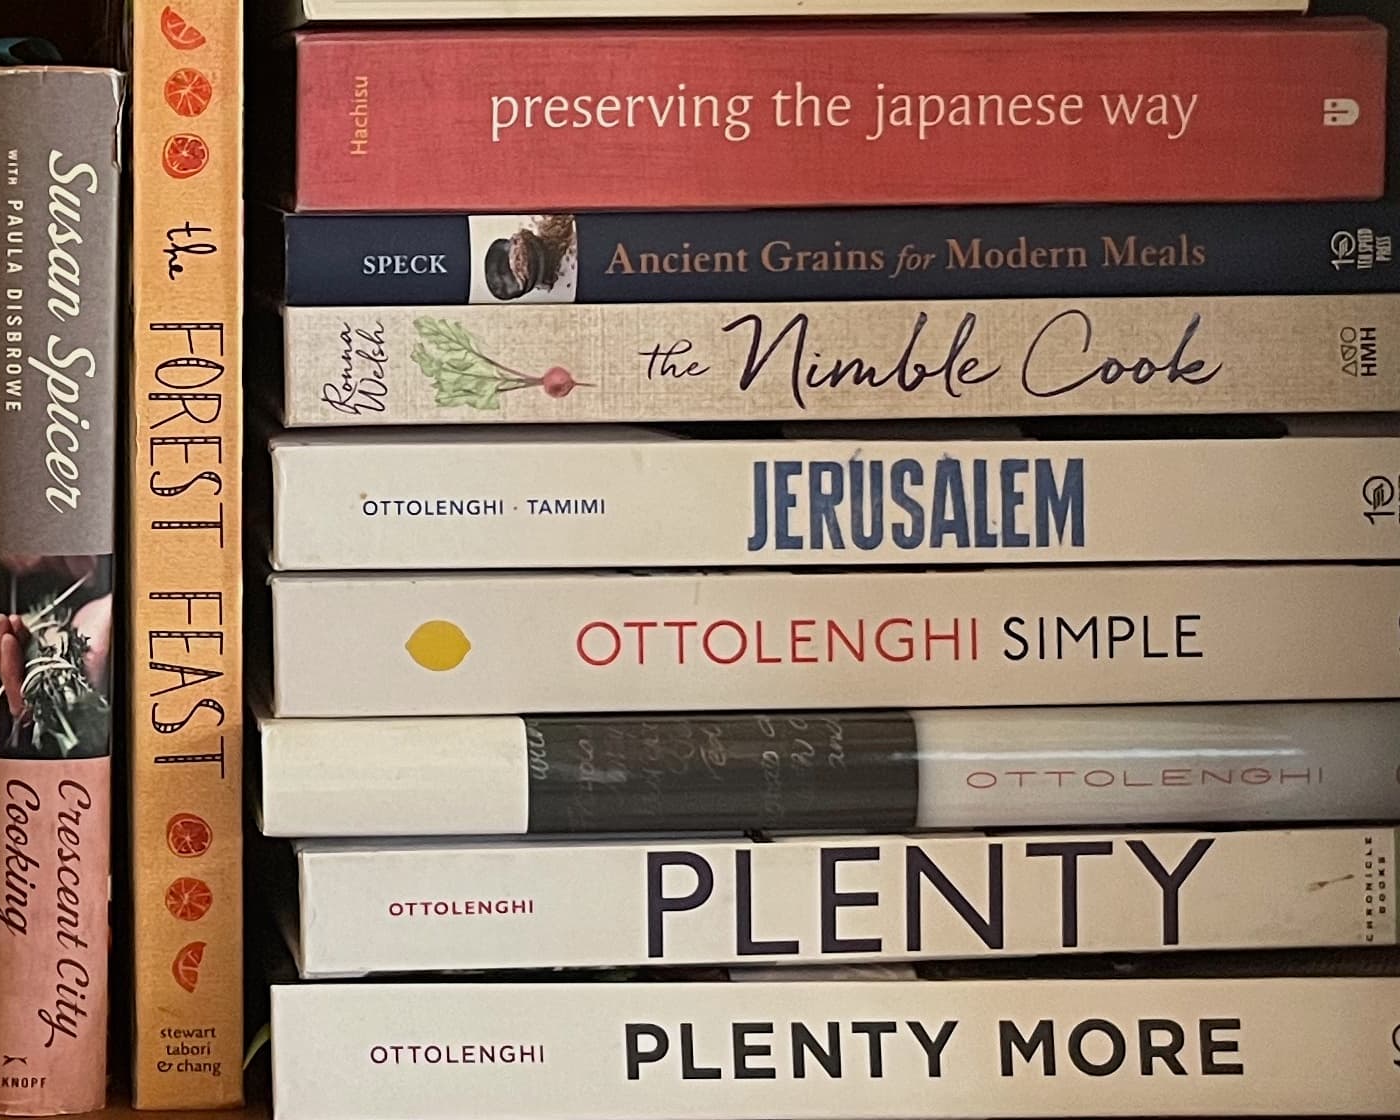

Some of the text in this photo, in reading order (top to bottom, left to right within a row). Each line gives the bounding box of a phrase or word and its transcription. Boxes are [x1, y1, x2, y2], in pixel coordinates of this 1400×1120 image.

[350, 75, 369, 156] Hachisu
[491, 82, 1198, 142] preserving the japanese way
[363, 255, 448, 275] SPECK
[605, 233, 1207, 278] Ancient Grains for Modern Meals
[1375, 236, 1391, 261] PRESS
[4, 149, 24, 412] WITH PAULA DISBROWE
[28, 149, 98, 513] Susan Spicer
[638, 309, 1224, 410] the Nimble Cook
[1361, 327, 1376, 376] HMH
[321, 321, 358, 415] Ronna
[352, 320, 389, 413] Welsh
[148, 221, 226, 779] the FOREST FEAST
[362, 498, 606, 516] OTTOLENGHI TAMIMI
[747, 458, 1085, 553] JERUSALEM
[576, 614, 1204, 666] OTTOLENGHI SIMPLE
[966, 767, 1324, 790] OTTOLENGHI
[42, 778, 91, 1048] Crescent City
[388, 900, 534, 917] OTTOLENGHI
[646, 838, 1216, 959] PLENTY
[1365, 837, 1374, 942] CHRONICLE
[1378, 857, 1386, 914] BOOKS
[159, 1026, 217, 1041] stewart
[166, 1041, 212, 1056] tabori
[370, 1044, 545, 1064] OTTOLENGHI
[625, 1017, 1245, 1081] PLENTY MORE
[1, 1077, 47, 1090] KNOPF
[157, 1059, 221, 1077] & chang
